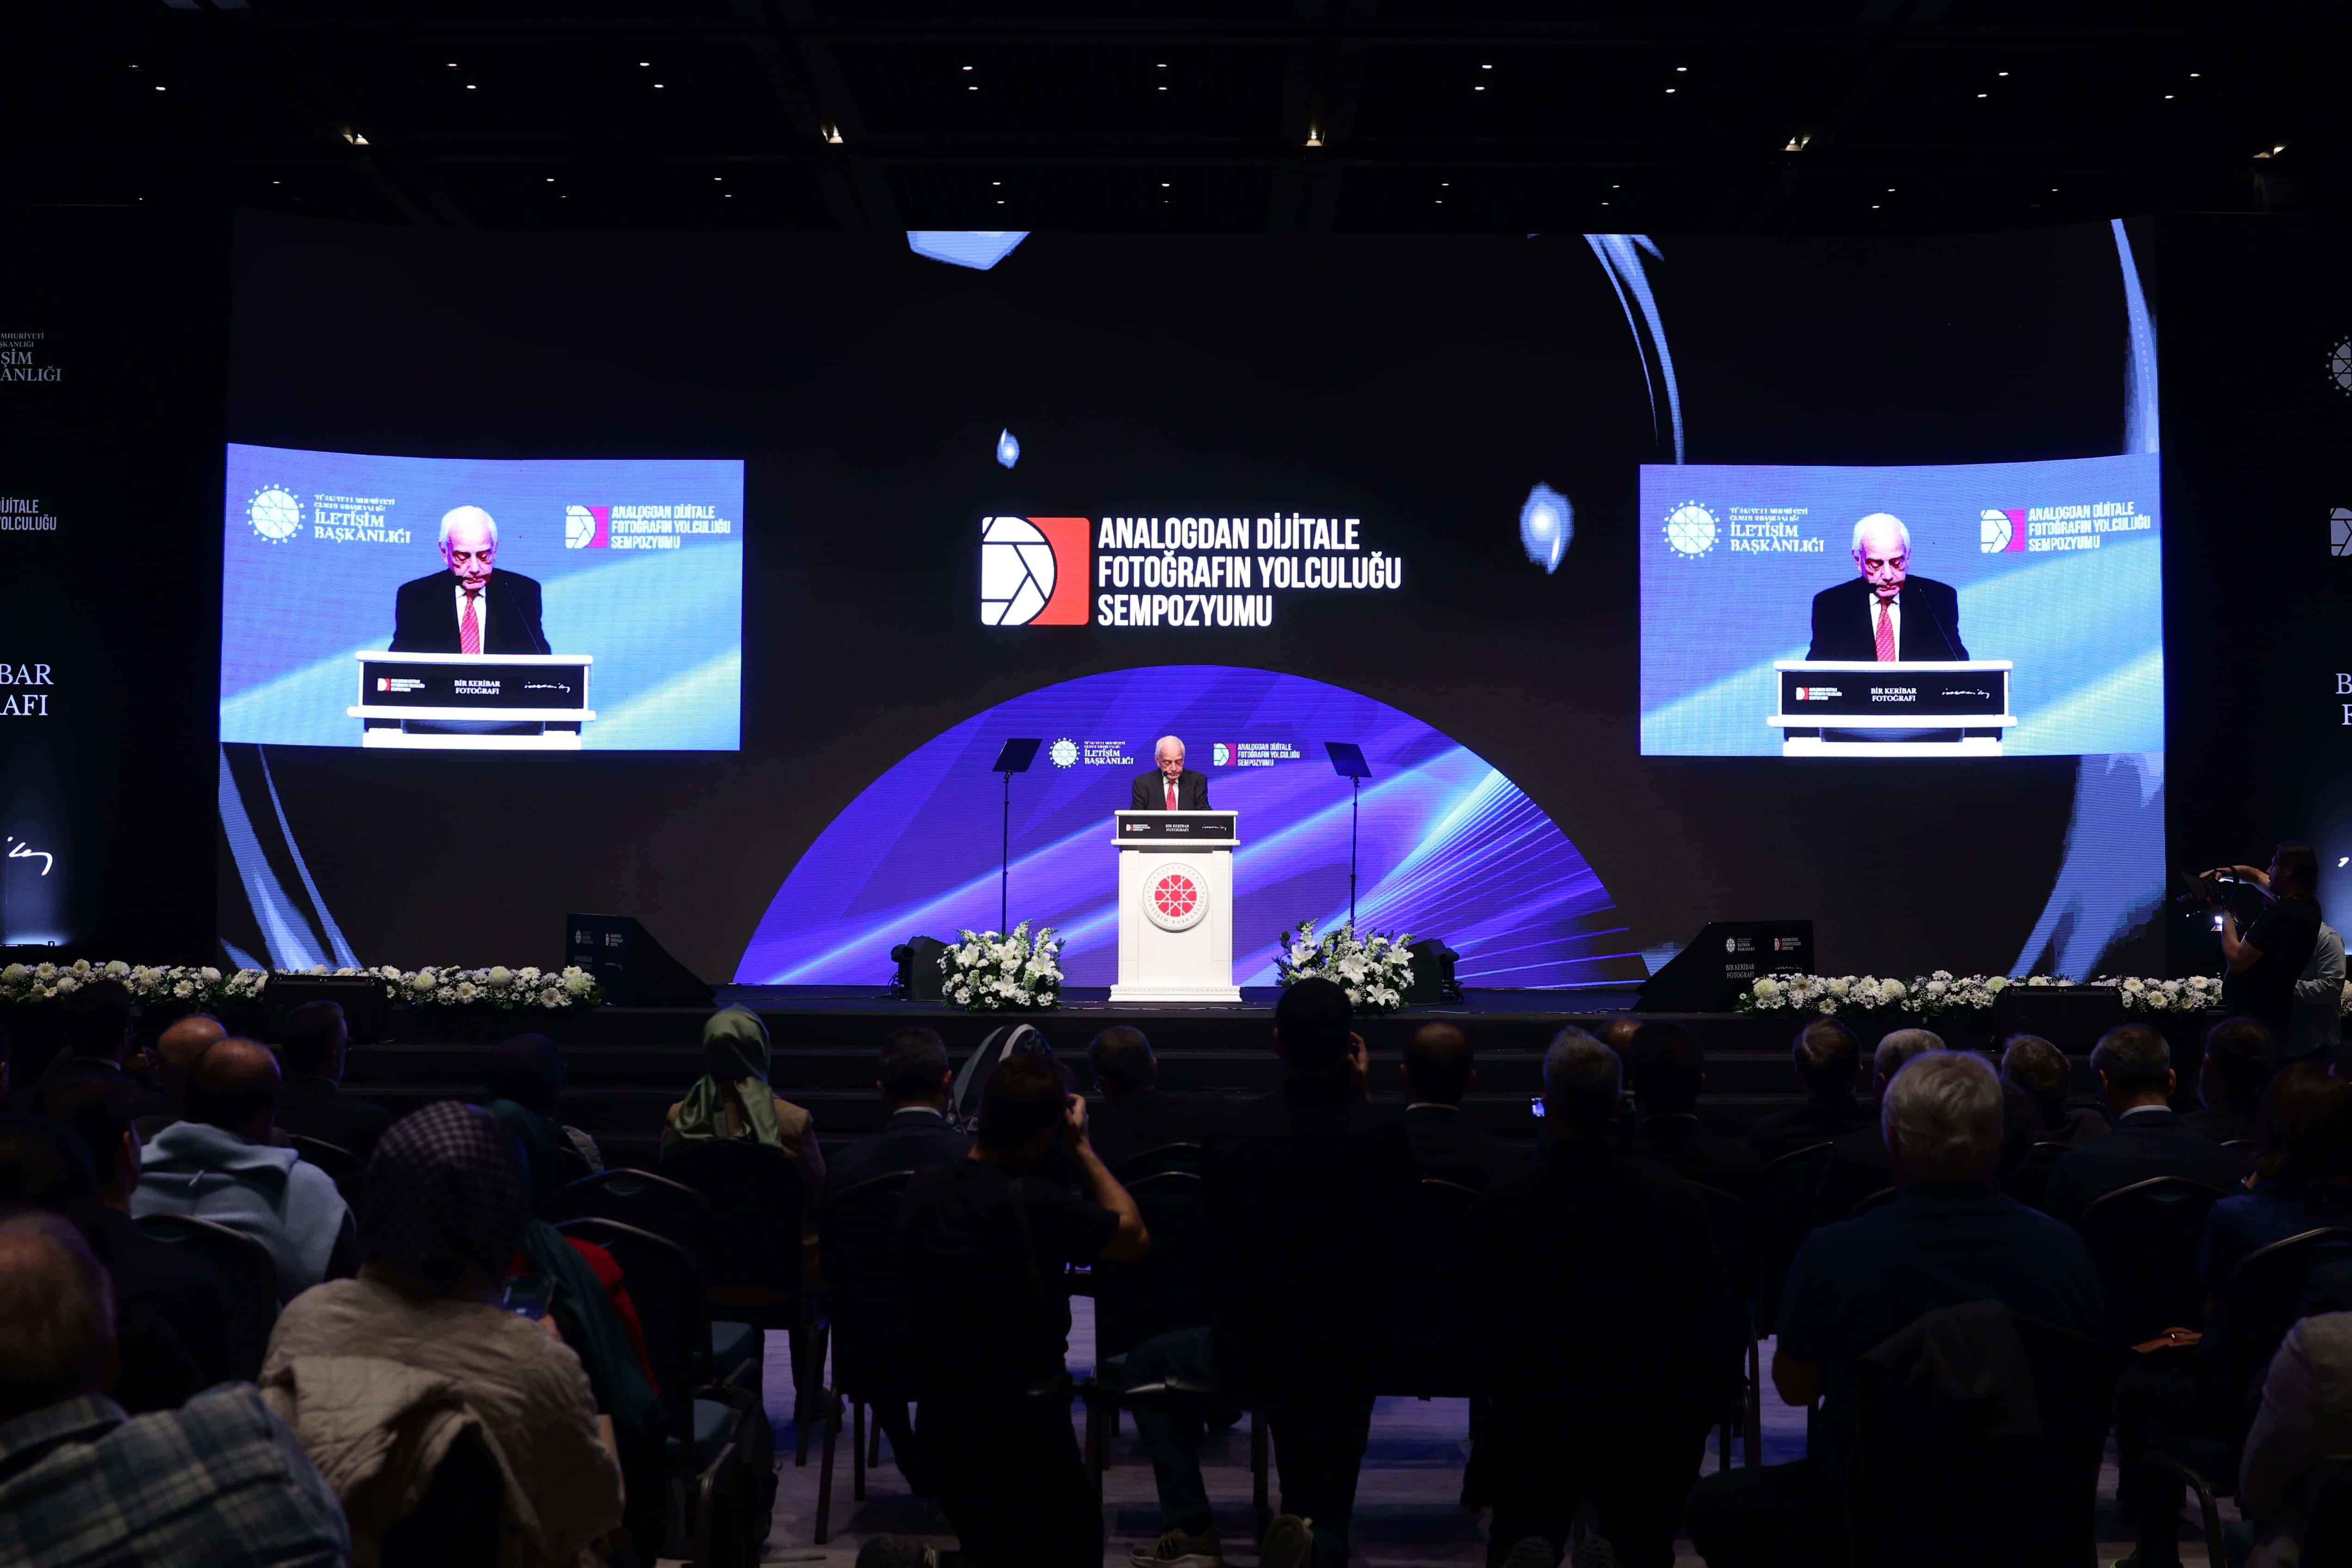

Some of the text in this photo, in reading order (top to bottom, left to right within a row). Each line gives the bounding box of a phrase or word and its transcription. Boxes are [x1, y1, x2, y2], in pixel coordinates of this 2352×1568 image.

[0, 496, 39, 513] İJİTALE
[612, 503, 716, 519] ANALOGDAN DİJİTALE
[2028, 502, 2134, 521] ANALOGDAN DİJİTALE
[0, 514, 57, 531] OLCULUĞU
[315, 508, 385, 528] İLETİŞİM
[612, 518, 730, 533] FOTOĞRAFIN YOLCULUĞU
[2029, 514, 2151, 535] FOTOĞRAFIN YOLCULUĞU
[314, 526, 411, 543] BAŞKANLIĞI
[1098, 513, 1360, 550] ANALOGDAN DİJİTALE
[1730, 521, 1799, 537] İLETİŞİM
[611, 535, 680, 549] SEMPOZYUMU
[1730, 537, 1824, 555] BAŞKANLIĞI
[2028, 535, 2100, 551] SEMPOZYUMU
[1098, 550, 1401, 588] FOTOĞRAFIN YOLCULUĞU
[1098, 594, 1272, 626] SEMPOZYUMU
[455, 686, 500, 694] FOTOĞRAFI
[1084, 748, 1120, 757] İLETİŞİM
[1084, 756, 1134, 766] BAŞKANLIĞI
[1270, 750, 1300, 758] YOLCULUĞU
